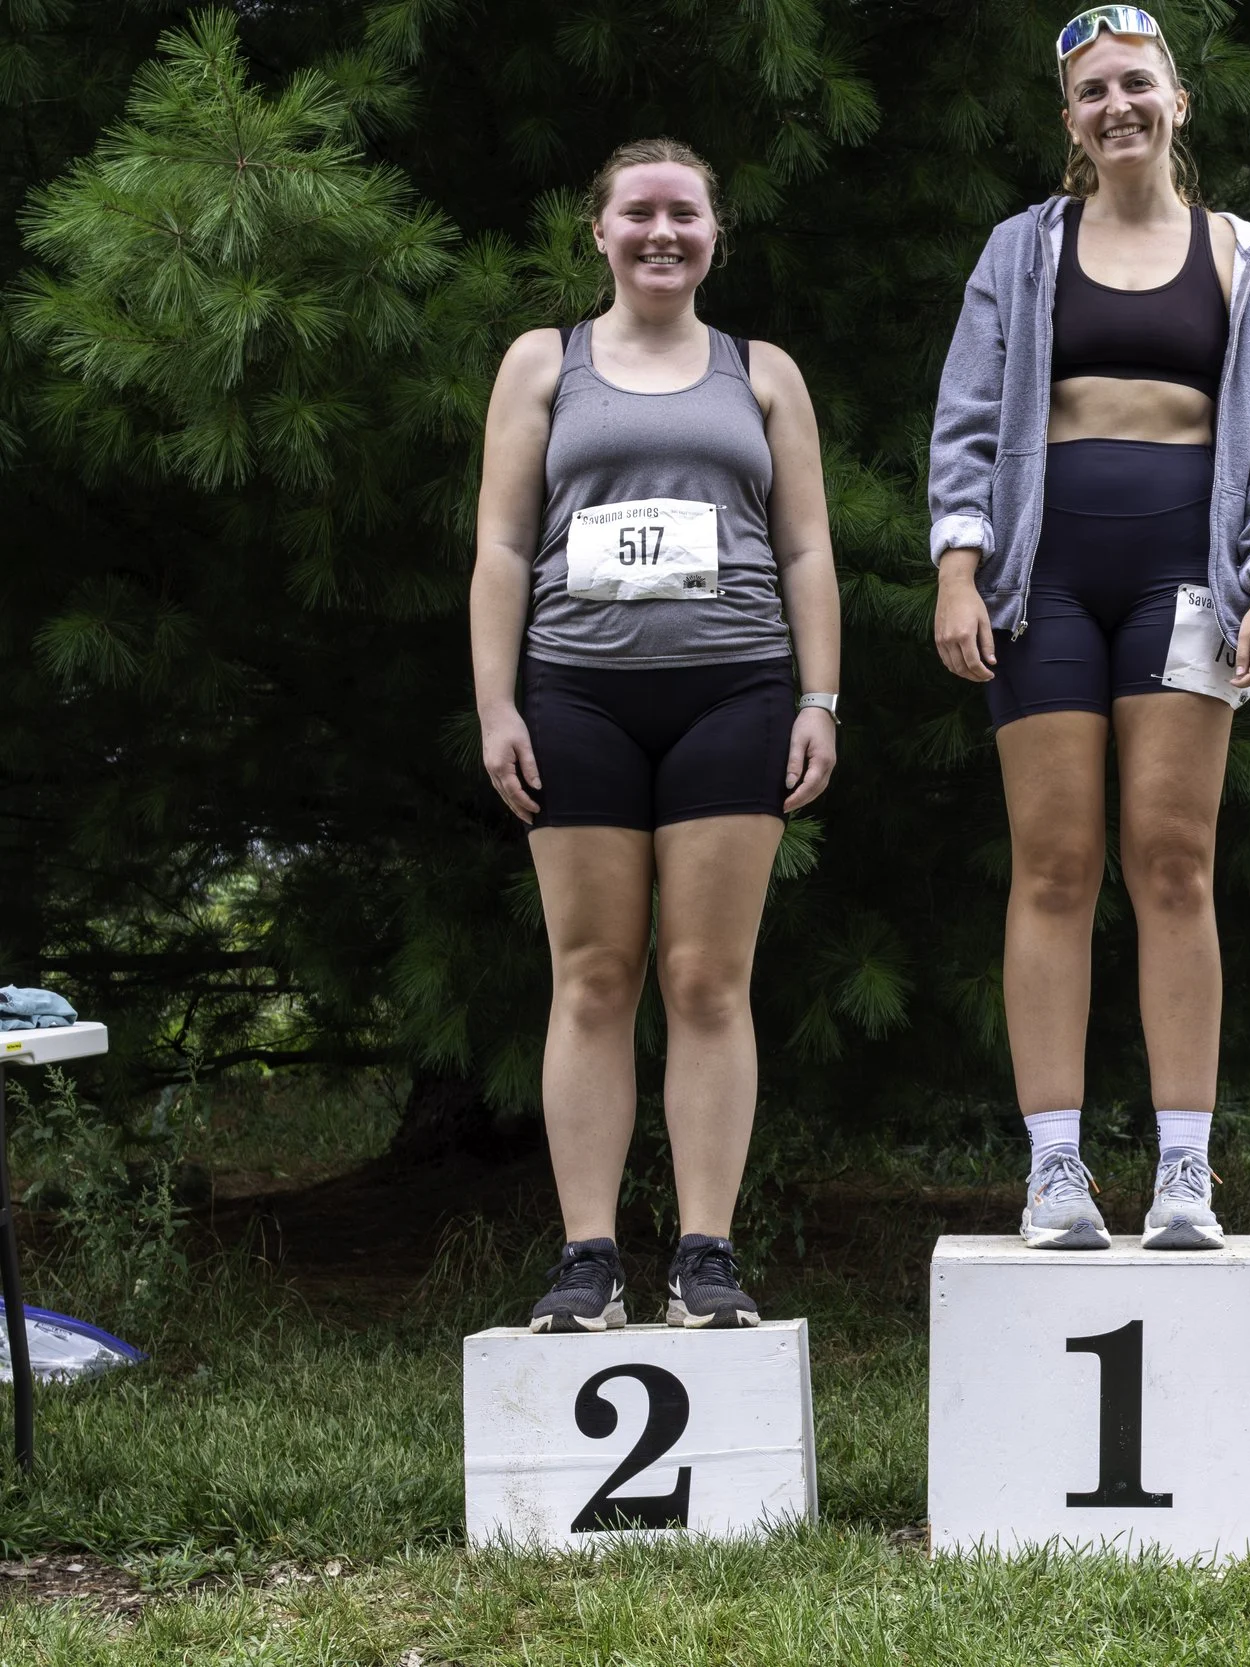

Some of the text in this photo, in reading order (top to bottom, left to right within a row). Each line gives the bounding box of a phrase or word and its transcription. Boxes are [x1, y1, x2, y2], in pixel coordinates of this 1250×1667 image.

[626, 507, 659, 519] series
[619, 526, 665, 566] 517
[1188, 592, 1215, 610] Sava
[1066, 1320, 1173, 1508] 1
[571, 1363, 690, 1533] 2
